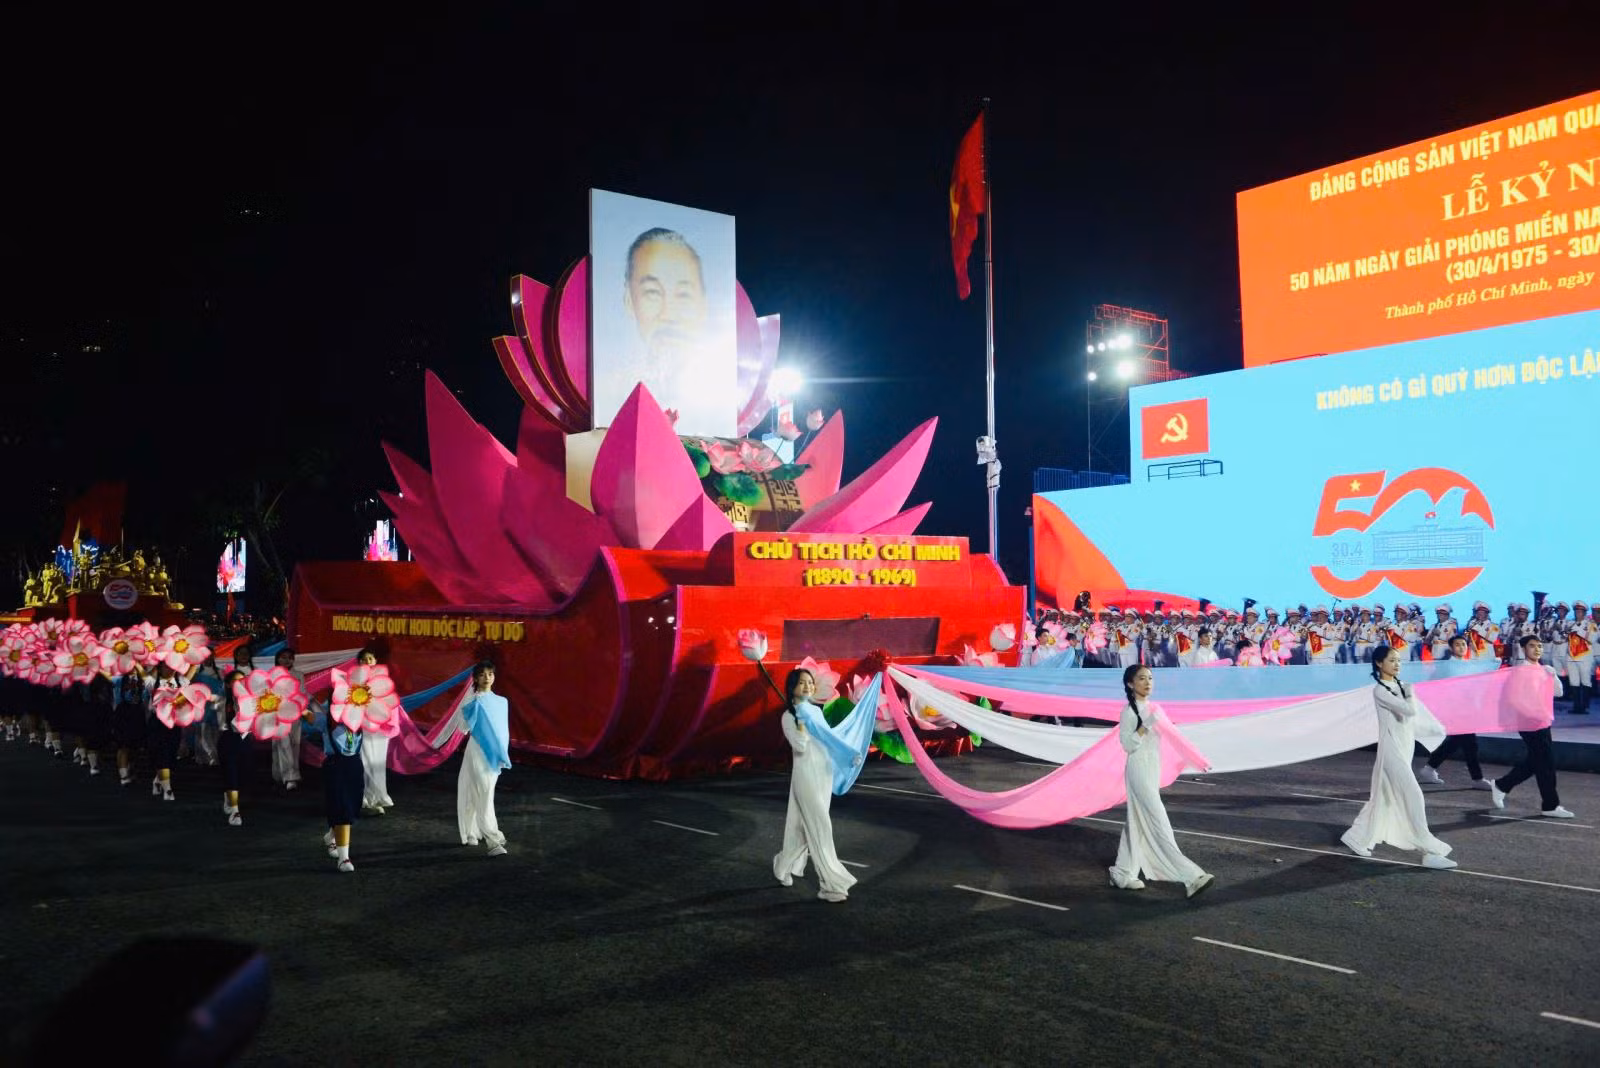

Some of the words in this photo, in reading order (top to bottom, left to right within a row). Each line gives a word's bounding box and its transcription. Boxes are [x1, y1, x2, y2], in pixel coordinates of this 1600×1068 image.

[1310, 172, 1356, 202] ĐẢNG
[1361, 160, 1410, 188] CỘNG
[1415, 142, 1455, 172] SẢN
[1460, 131, 1502, 160] VIỆT
[1508, 116, 1558, 149] NAM
[1441, 172, 1489, 221] LỄ
[1500, 160, 1556, 207] KỶ
[1568, 156, 1600, 192] N
[1290, 271, 1309, 291] 50
[1313, 262, 1350, 287] NĂM
[1354, 250, 1400, 277] NGÀY
[1405, 238, 1440, 267] GIẢI
[1446, 228, 1510, 258] PHÓNG
[1446, 244, 1548, 284] (30/4/1975
[1385, 301, 1424, 319] Thành
[1427, 293, 1454, 315] phố
[1456, 289, 1477, 307] Hồ
[1480, 285, 1507, 302] Chí
[1510, 278, 1552, 297] Minh,
[1558, 271, 1595, 289] ngày
[1316, 384, 1375, 410] KHÔNG
[1380, 377, 1403, 402] CÓ
[1408, 373, 1427, 398] GÌ
[1431, 367, 1468, 397] QUÝ
[1474, 363, 1515, 390] HƠN
[1521, 356, 1563, 384] ĐỘC
[1570, 348, 1600, 379] LẬ
[749, 537, 793, 560] CHỦ
[797, 542, 842, 564] TỊCH
[847, 537, 877, 560] HỒ
[880, 540, 912, 561] CHÍ
[914, 544, 960, 561] MINH
[1331, 541, 1364, 557] 30.4
[806, 567, 855, 587] (1890
[871, 568, 917, 588] 1969)
[333, 613, 360, 632] KHÔNG
[504, 621, 524, 641] DO
